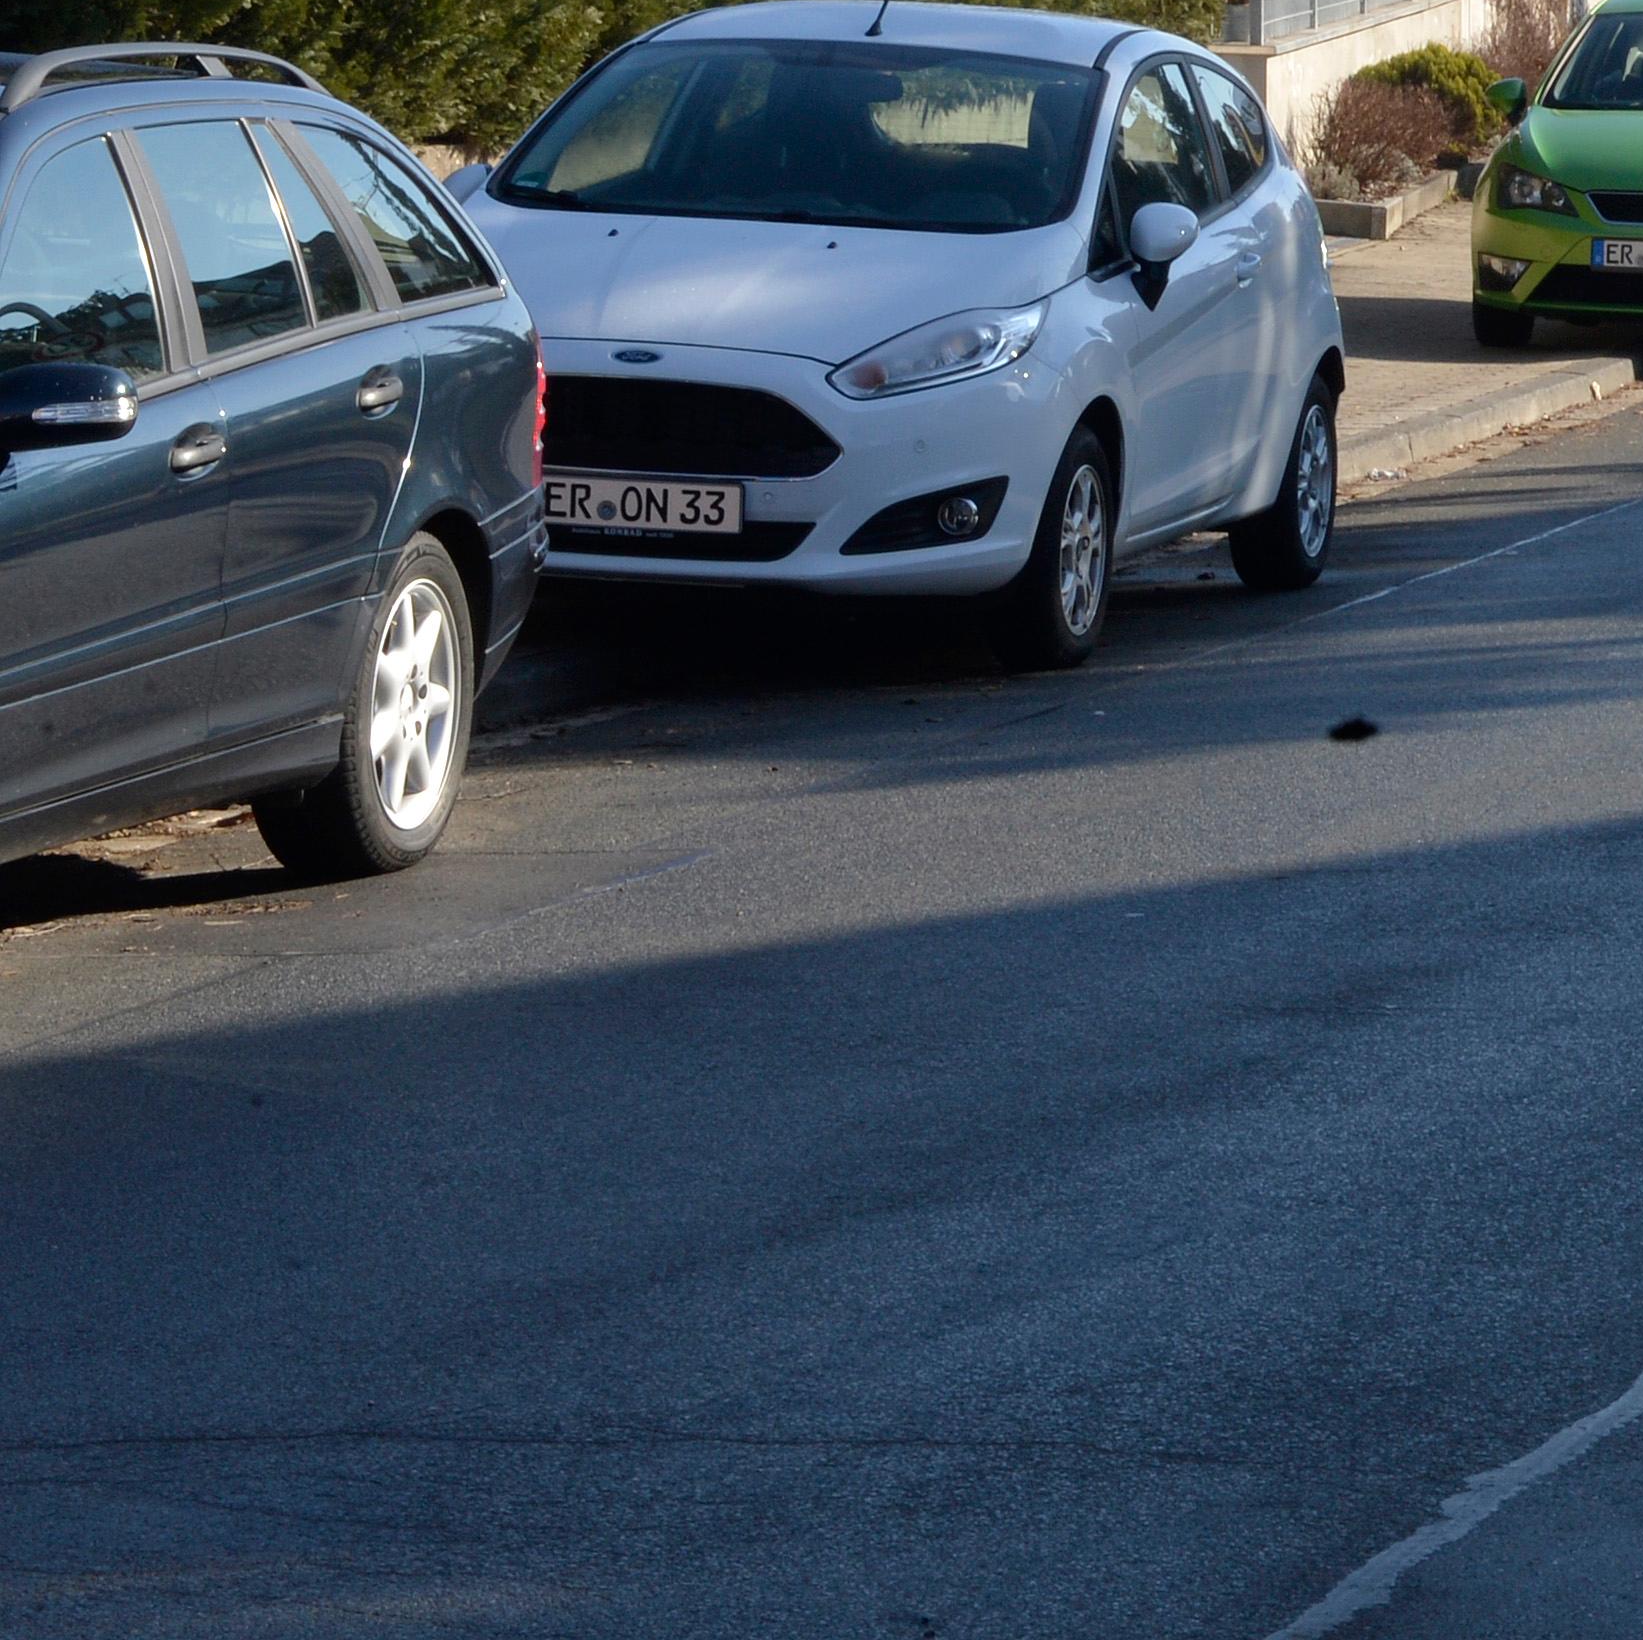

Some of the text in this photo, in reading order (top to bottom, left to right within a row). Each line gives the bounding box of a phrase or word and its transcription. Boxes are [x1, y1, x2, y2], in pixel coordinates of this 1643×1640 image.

[1606, 244, 1633, 264] ER
[545, 482, 726, 525] ER ON 33
